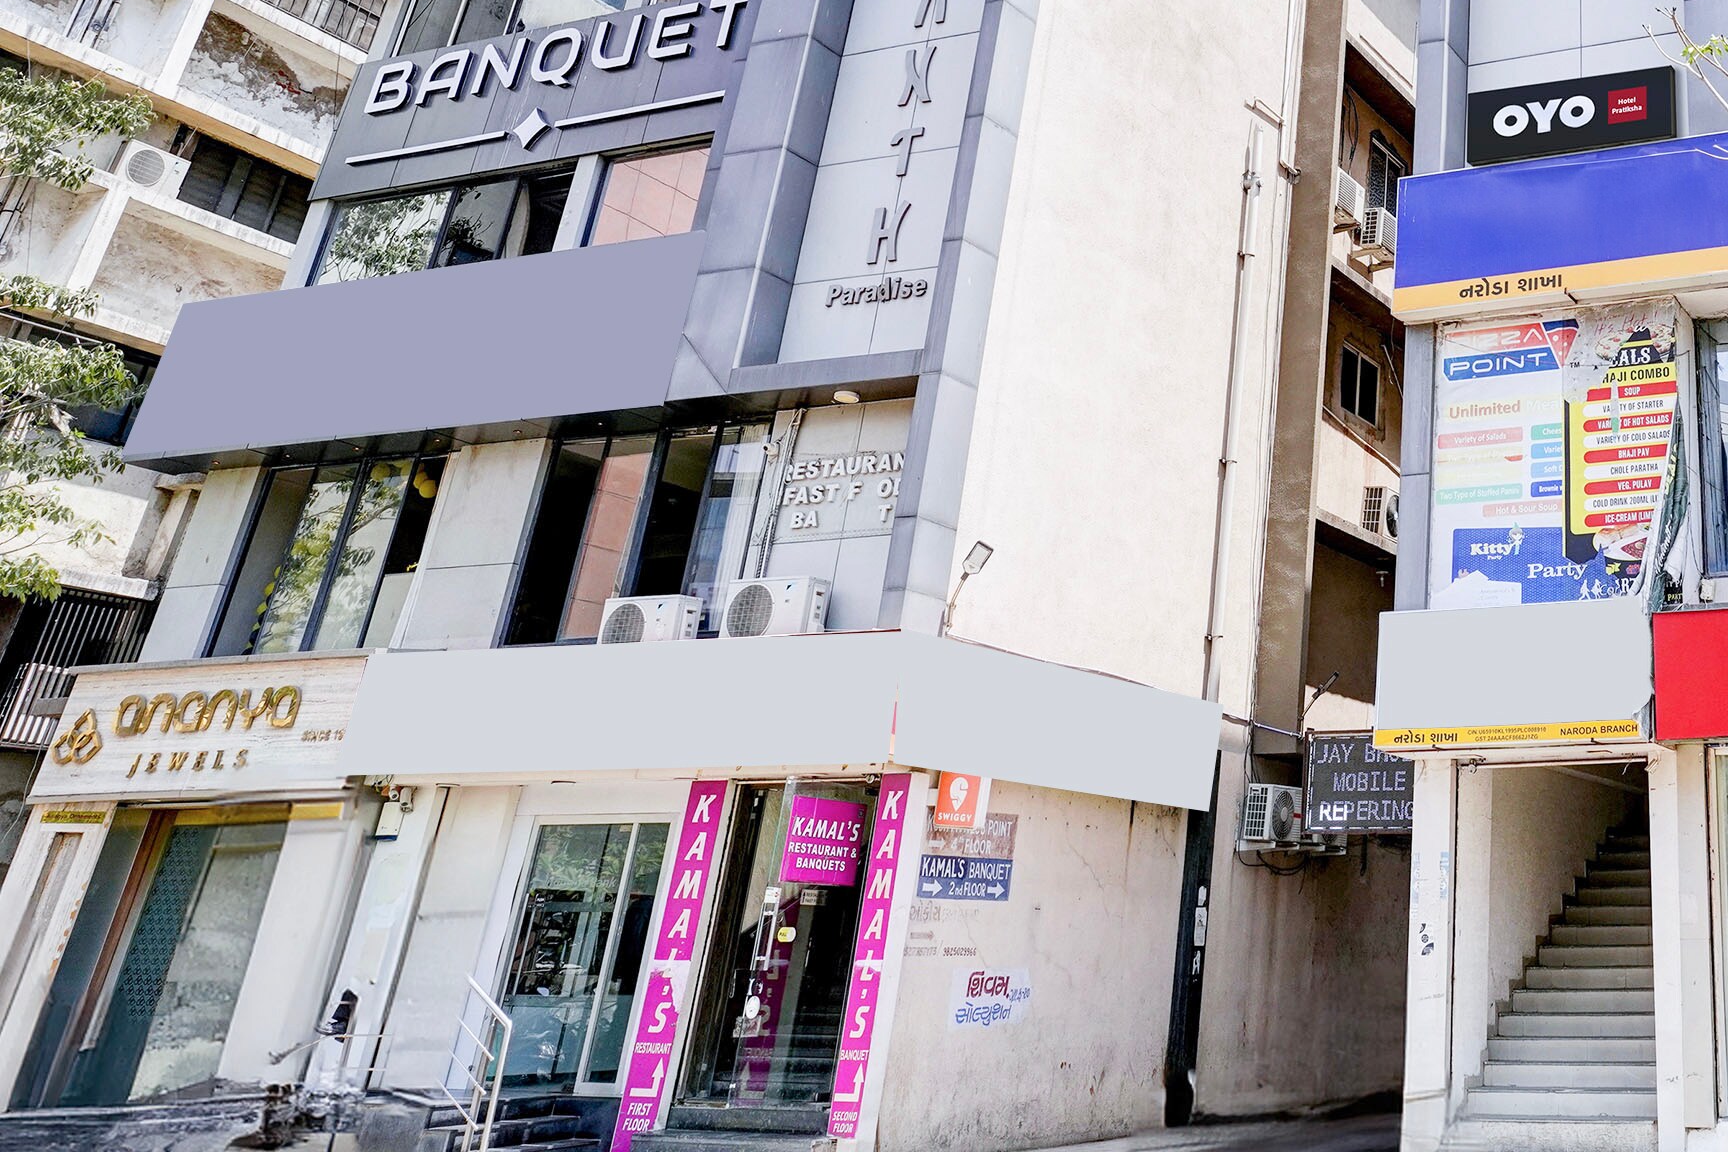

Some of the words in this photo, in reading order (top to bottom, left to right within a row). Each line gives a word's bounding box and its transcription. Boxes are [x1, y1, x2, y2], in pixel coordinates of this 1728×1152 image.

[1617, 96, 1637, 105] Hotel
[1493, 95, 1596, 137] OYO
[1611, 105, 1643, 115] Pratiksha
[825, 276, 928, 308] Paradise
[1459, 277, 1509, 299] નરોડા
[1517, 274, 1563, 293] શાખા
[1450, 353, 1548, 376] POINT
[1630, 366, 1670, 381] COMBO
[1624, 387, 1641, 396] SOUP
[1449, 400, 1521, 419] Unlimited
[1627, 402, 1636, 411] OF
[1637, 399, 1664, 409] STARTER
[1624, 417, 1631, 426] OF
[1632, 416, 1645, 426] HOT
[1646, 414, 1670, 424] SALADS
[1623, 434, 1630, 442] OF
[1631, 432, 1647, 441] COLD
[1648, 430, 1671, 439] SALADS
[1618, 449, 1637, 459] BHAJI
[1637, 448, 1650, 457] PAV
[1610, 465, 1629, 475] CHOLE
[1630, 463, 1659, 473] PARATHA
[1632, 479, 1652, 489] PULAV
[781, 483, 840, 506] FAST
[1496, 505, 1510, 515] Hot
[1518, 504, 1537, 513] Sour
[1538, 503, 1558, 513] Soup
[1592, 499, 1608, 508] COLD
[1609, 497, 1628, 507] DRINK
[1604, 512, 1637, 523] ICE-CREAM
[1470, 542, 1513, 556] Kitty
[1527, 562, 1588, 581] Party
[1393, 729, 1425, 744] નરોડા
[1430, 731, 1458, 743] શાખા
[1559, 725, 1598, 736] NARODA
[1600, 723, 1638, 734] BRANCH
[1317, 742, 1354, 765] JAY
[126, 748, 249, 780] JEWELS
[1333, 770, 1407, 793] MOBILE
[937, 812, 973, 822] SWIGGY
[1319, 799, 1414, 822] REPERING
[791, 815, 861, 842] KAMAL'S
[987, 819, 1013, 837] POINT
[787, 841, 849, 858] RESTAURANT
[850, 847, 857, 858] &
[963, 838, 992, 854] FLOOR
[796, 857, 846, 872] BANQUETS
[921, 856, 966, 879] KAMAL'S
[968, 862, 1011, 882] BANQUET
[963, 882, 987, 897] FLOOR
[634, 1041, 672, 1055] RESTAURANT
[839, 1048, 870, 1061] BANQUET
[627, 1101, 653, 1116] FIRST
[832, 1109, 859, 1122] SECOND
[622, 1116, 650, 1132] FLOOR
[832, 1122, 855, 1135] FLOOR
